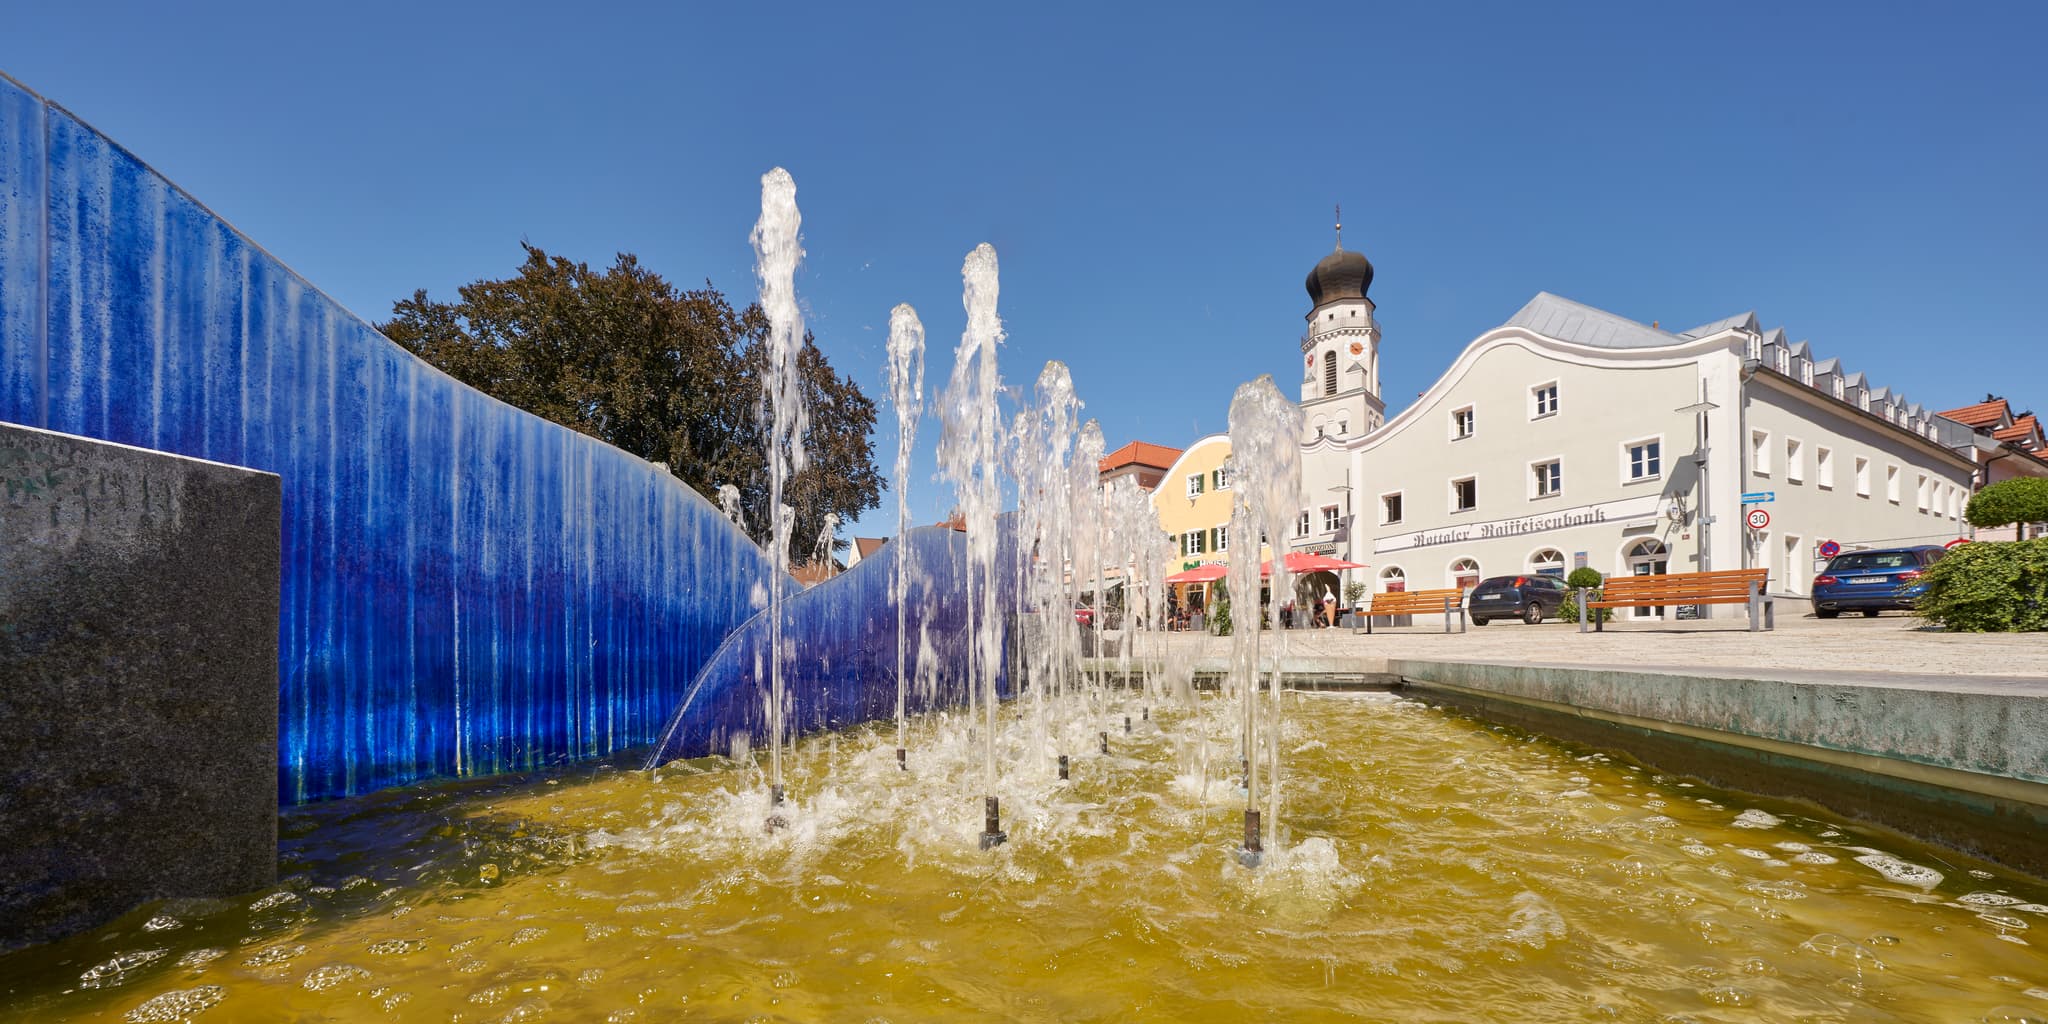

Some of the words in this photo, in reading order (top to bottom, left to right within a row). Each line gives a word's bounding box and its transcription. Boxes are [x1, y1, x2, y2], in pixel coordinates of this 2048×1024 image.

[1413, 530, 1470, 547] Rottaler
[1480, 508, 1606, 537] Raiffeisenbank
[1751, 514, 1766, 524] 30
